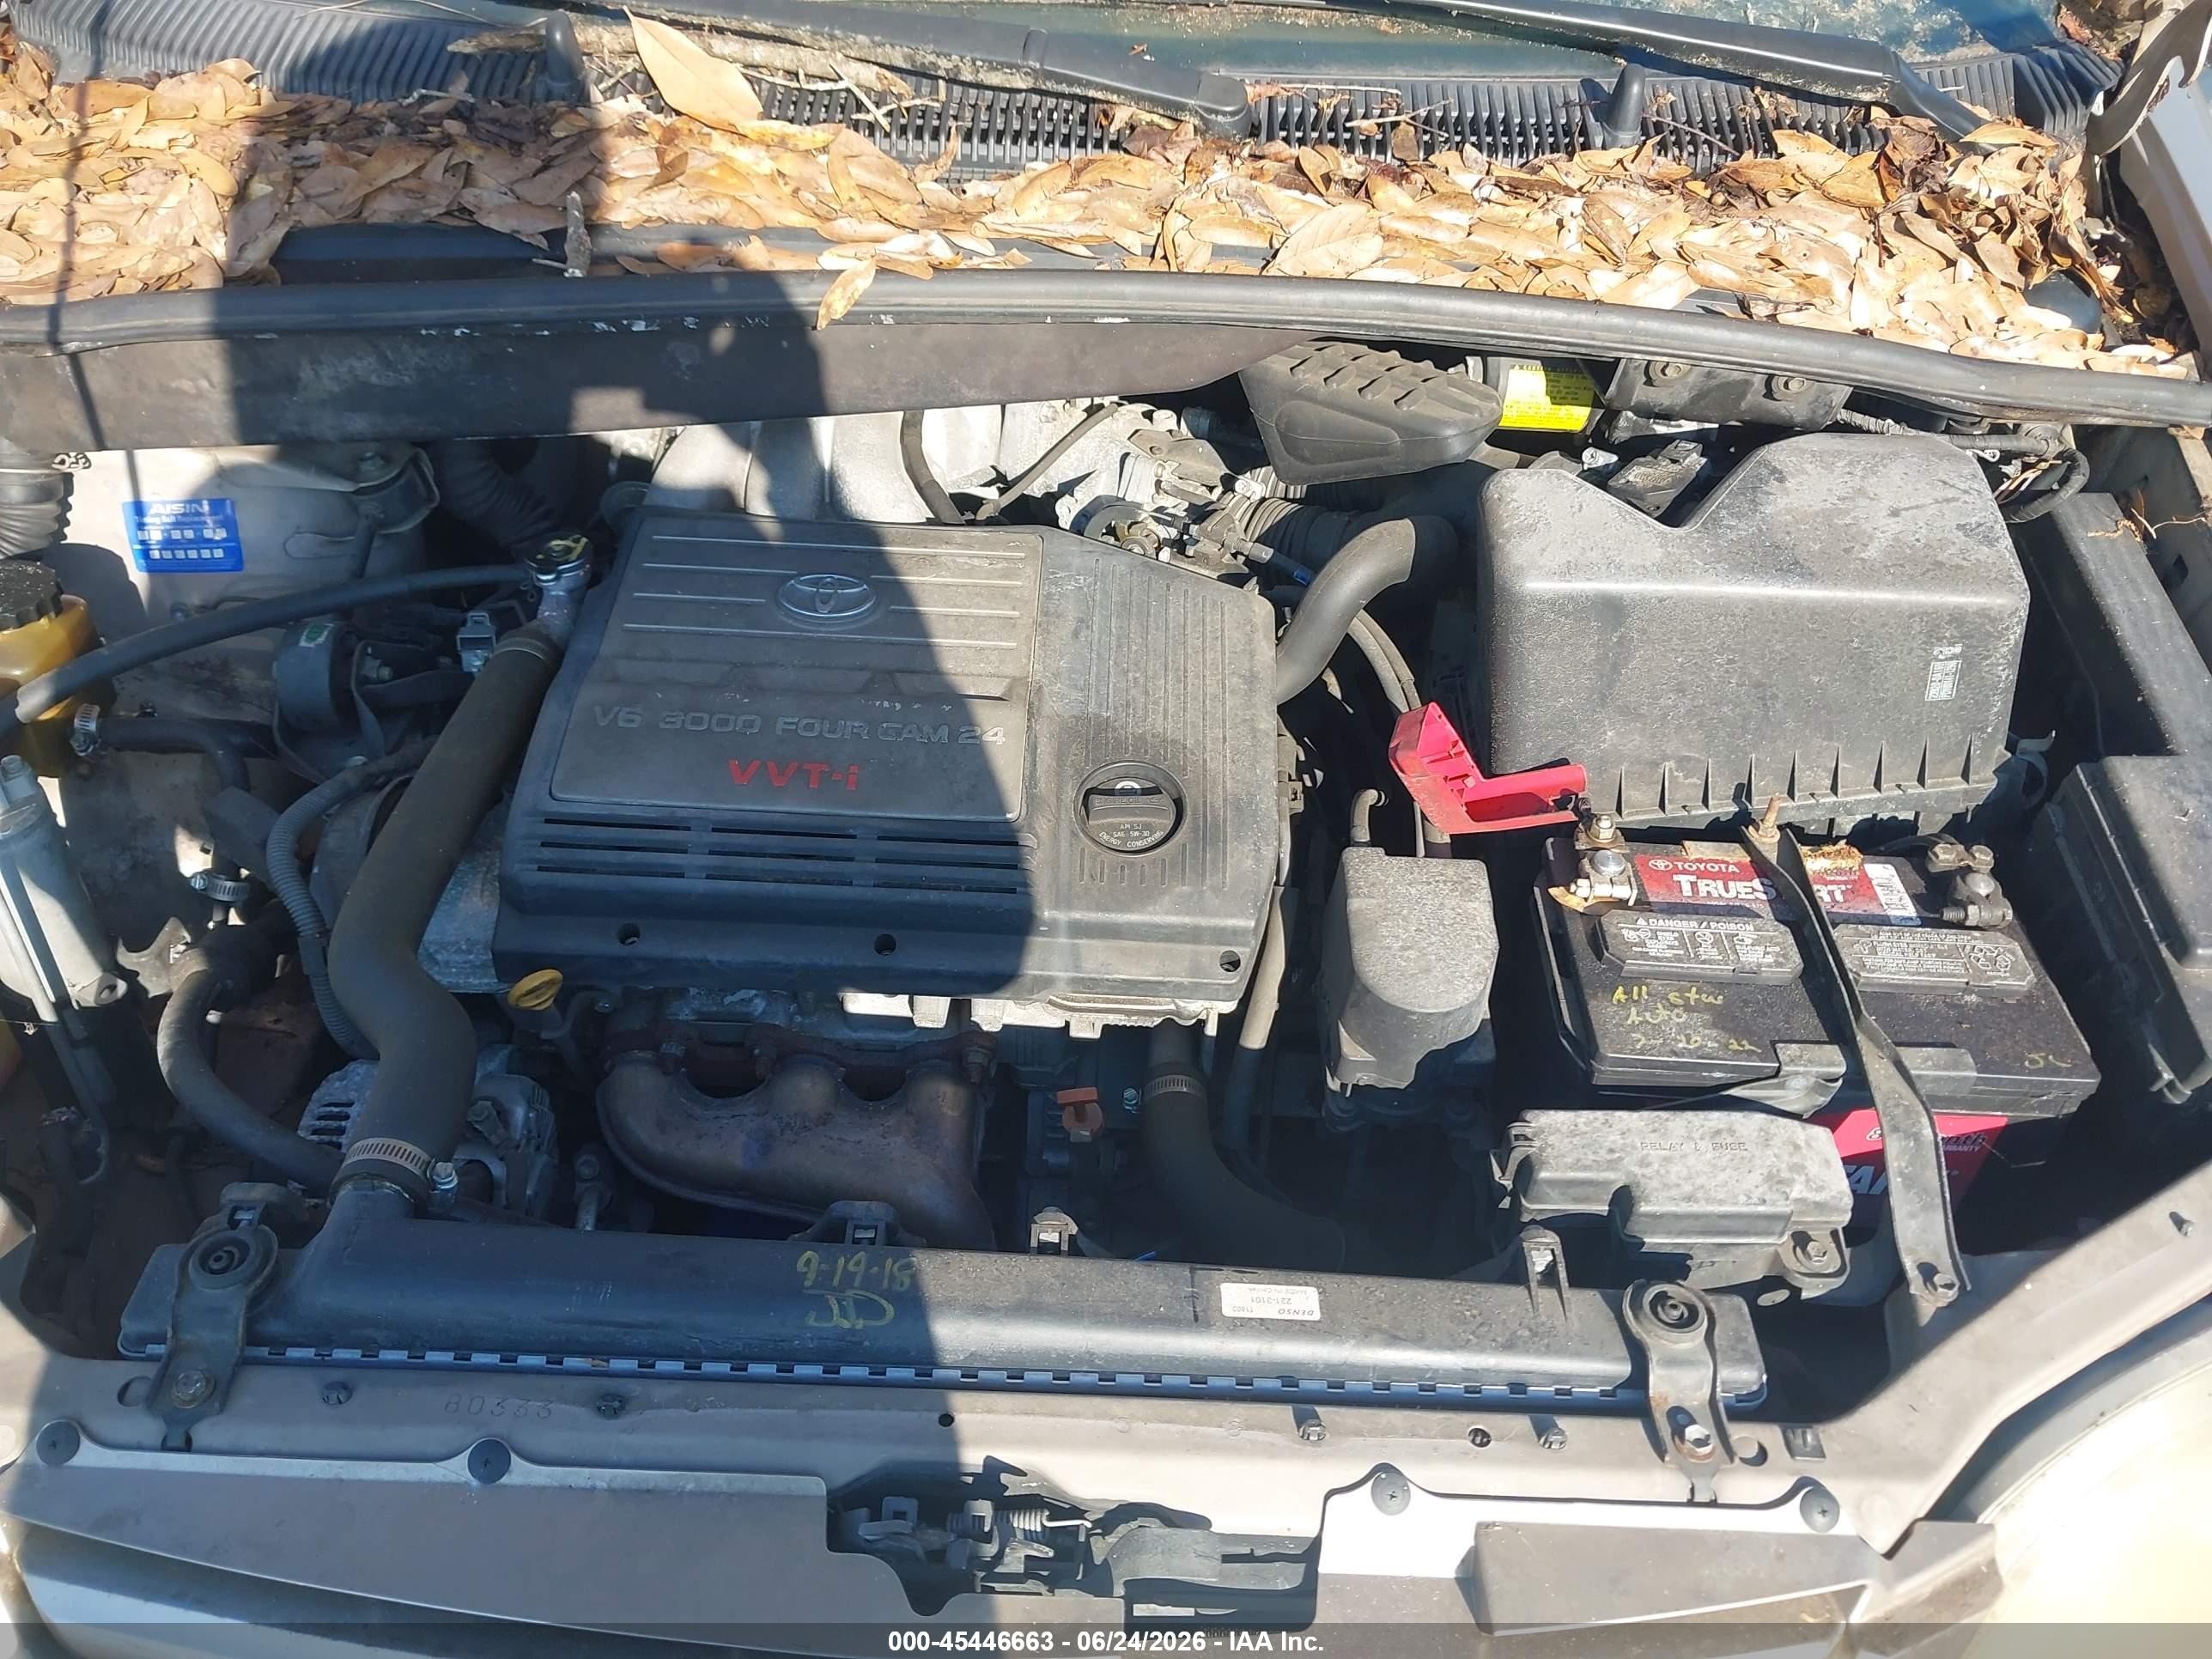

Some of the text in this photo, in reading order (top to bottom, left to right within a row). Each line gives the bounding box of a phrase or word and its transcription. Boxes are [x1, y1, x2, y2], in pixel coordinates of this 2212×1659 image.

[149, 502, 208, 514] AISIN
[593, 705, 1006, 745] V6 3000 FOUR CAM 24
[729, 758, 860, 790] VVT-i
[1099, 830, 1164, 848] ENERGY CONSERVING
[1674, 861, 1740, 873] TOYOTA
[1649, 919, 1698, 929] DANGER
[1711, 921, 1754, 932] POISON
[1639, 1141, 1684, 1152] RELAY
[1711, 1142, 1748, 1152] FUSE
[797, 1250, 917, 1292] 9-19-18
[1250, 1297, 1292, 1305] 221-3101
[1278, 1308, 1316, 1316] DENSO
